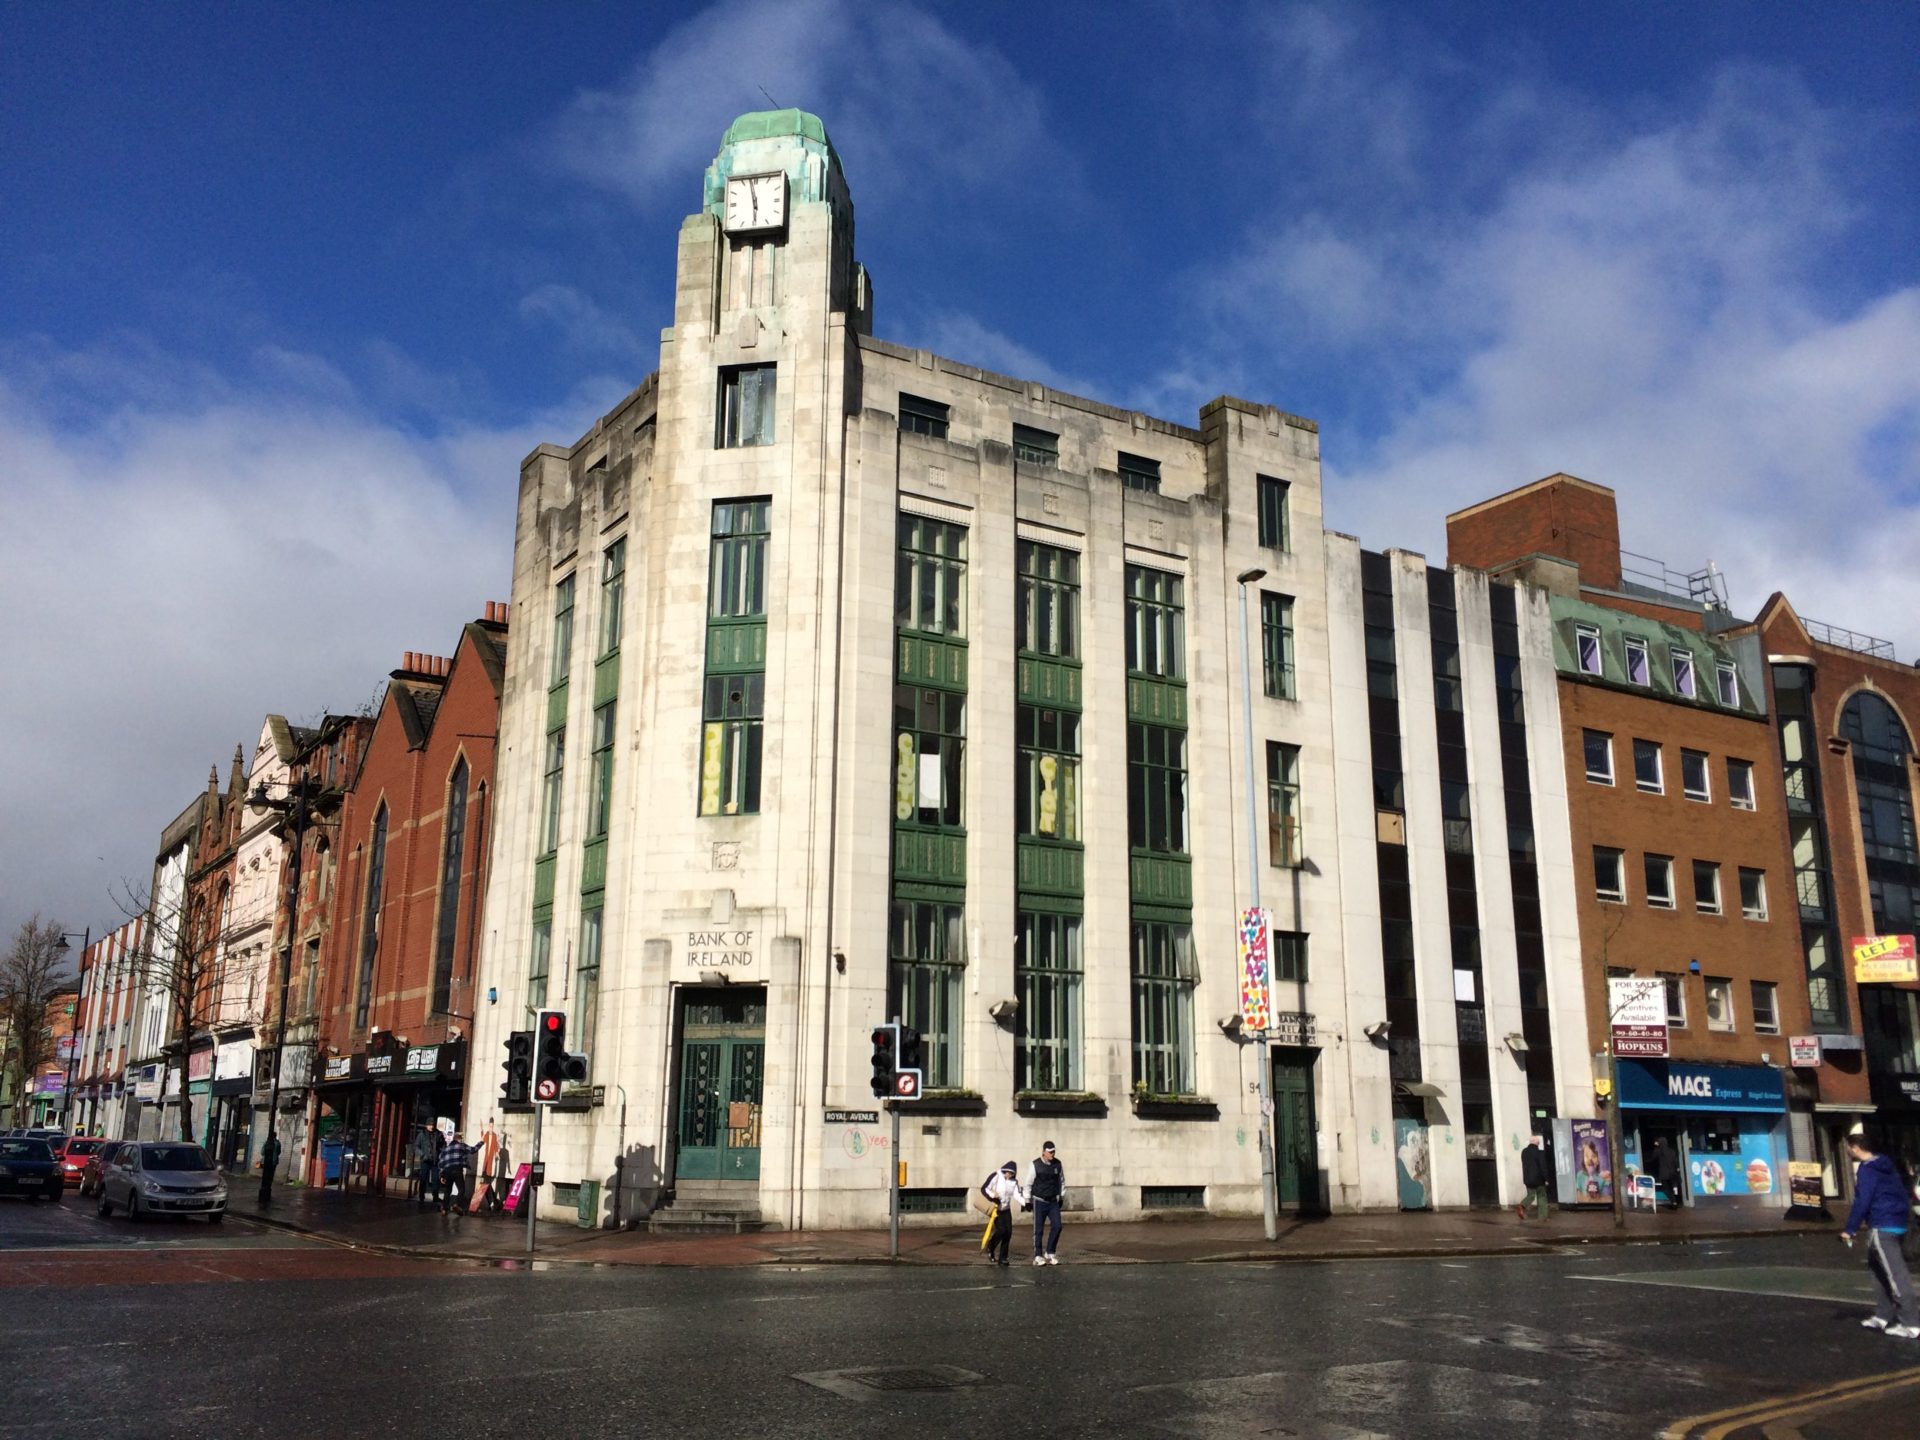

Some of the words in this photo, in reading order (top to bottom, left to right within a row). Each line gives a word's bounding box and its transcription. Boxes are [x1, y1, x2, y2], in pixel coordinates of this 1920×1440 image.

[688, 931, 728, 947] BANK
[734, 931, 753, 946] OF
[1860, 942, 1887, 958] LET
[687, 951, 753, 967] IRELAND
[1617, 1043, 1663, 1051] HOPKINS
[1668, 1075, 1712, 1097] MACE
[1715, 1089, 1742, 1099] Express
[850, 1113, 875, 1121] AVENUE
